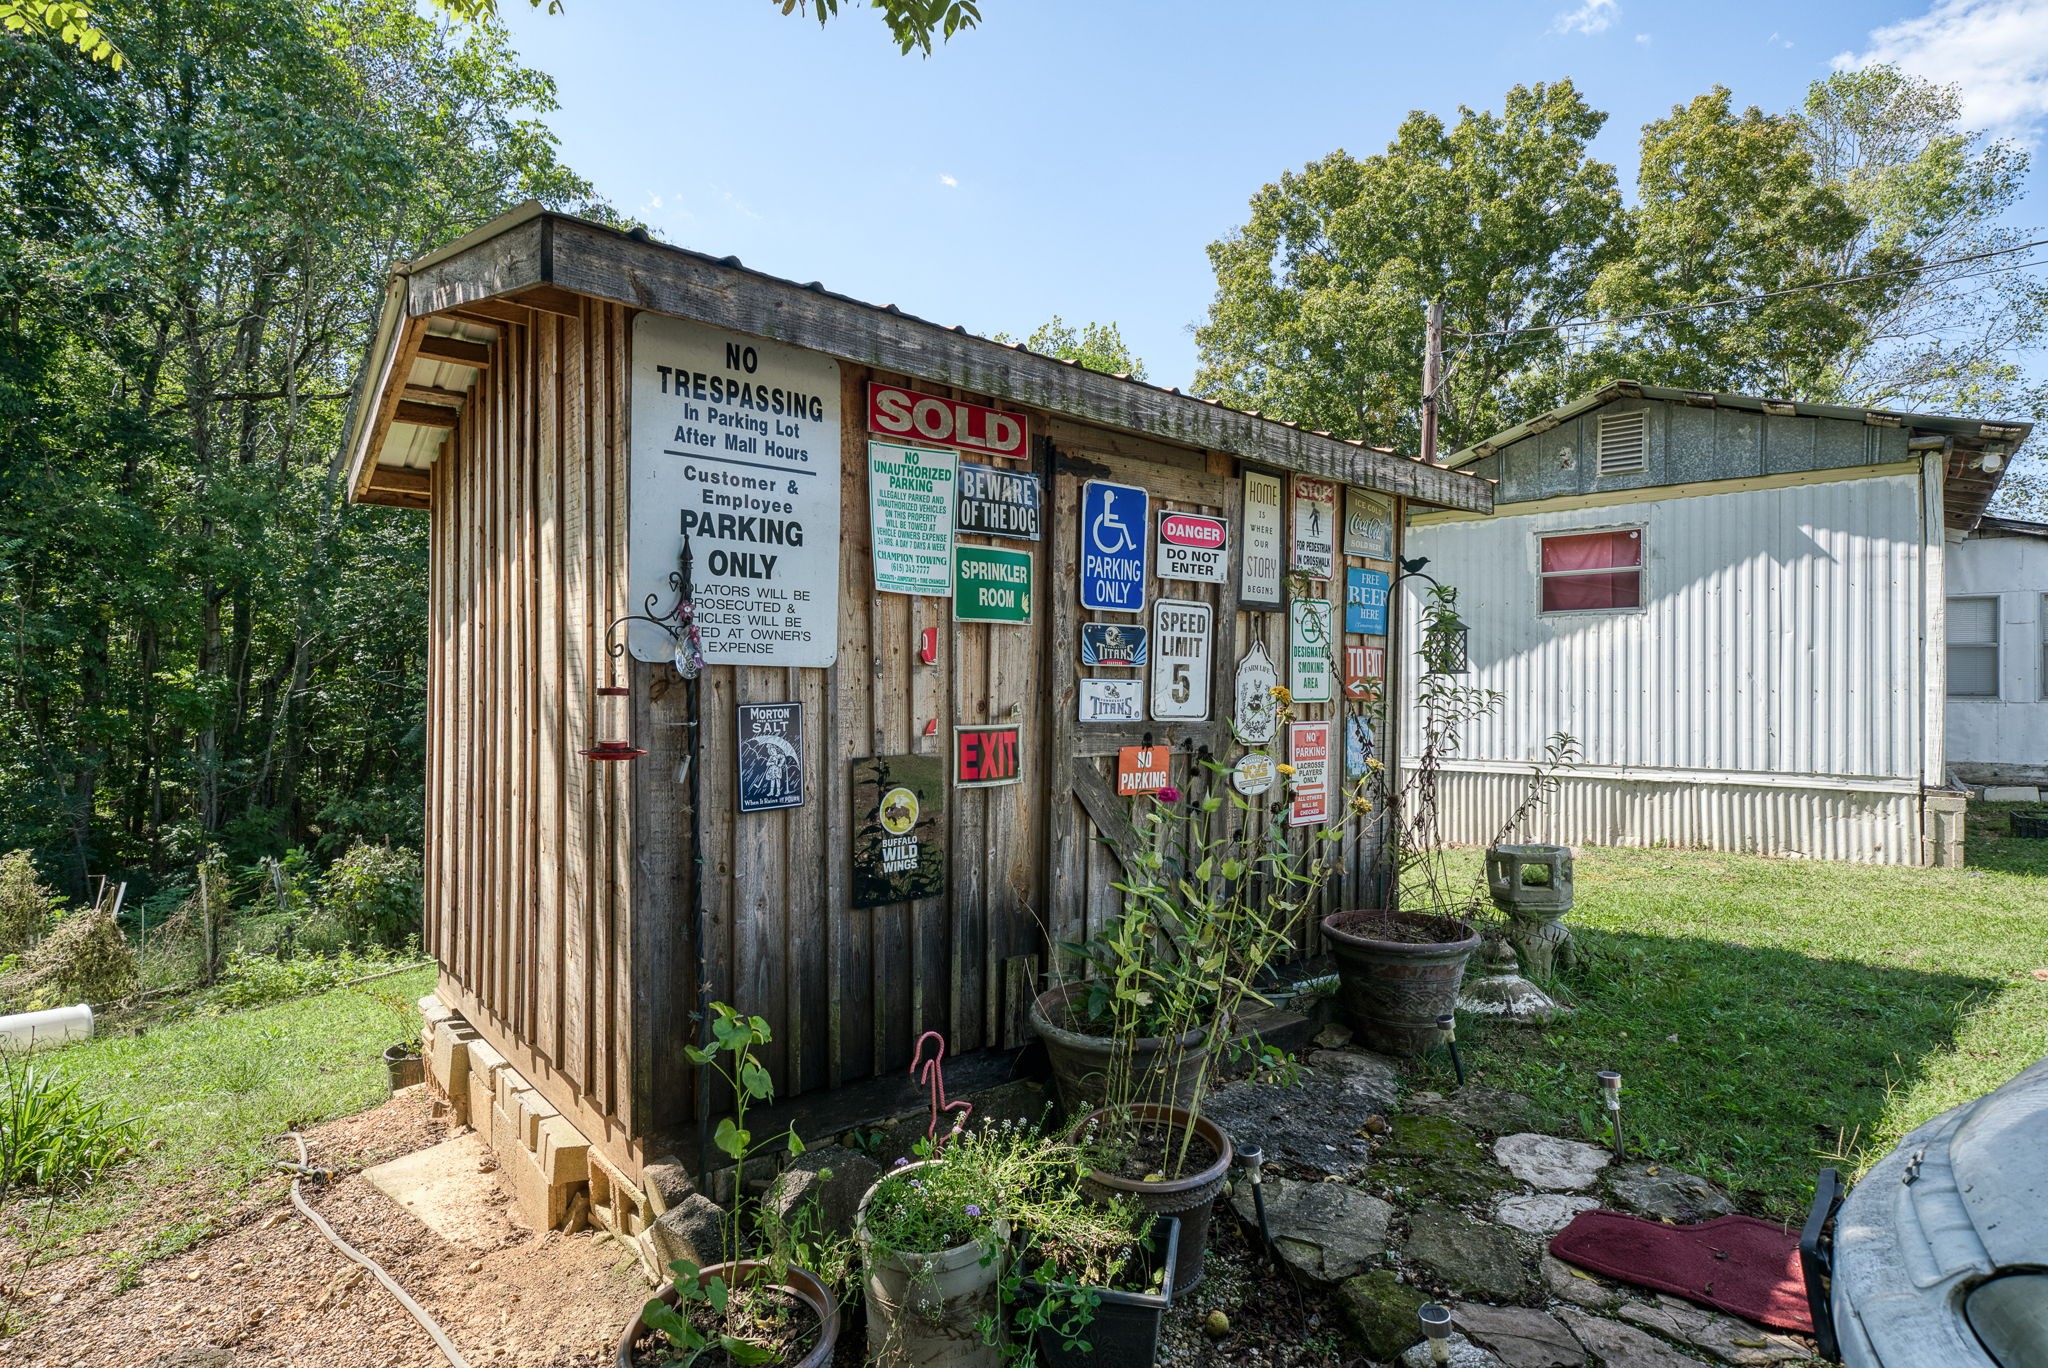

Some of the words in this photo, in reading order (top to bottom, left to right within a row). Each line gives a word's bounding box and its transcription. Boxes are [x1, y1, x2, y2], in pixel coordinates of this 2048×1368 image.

[726, 342, 758, 374] NO
[656, 365, 823, 423] TRESPASSING
[684, 403, 699, 421] In
[707, 407, 768, 436] Parking
[776, 419, 800, 439] Lot
[875, 389, 1022, 451] SOLD
[674, 426, 716, 447] After
[725, 433, 757, 454] Mall
[765, 439, 809, 462] Hours
[904, 451, 919, 465] NO
[874, 460, 952, 482] UNAUTHORIZED
[683, 465, 776, 492] Customer
[787, 480, 799, 495] &
[889, 475, 933, 493] PARKING
[963, 471, 1033, 505] BEWARE
[702, 489, 793, 514] Employee
[879, 489, 907, 501] ILLEGALLY
[908, 493, 931, 504] PARKED
[932, 496, 944, 505] AND
[1249, 481, 1277, 507] HOME
[877, 498, 918, 512] UNAUTHORIZED
[919, 504, 947, 514] VEHICLES
[1355, 498, 1366, 509] ICE
[885, 509, 893, 518] ON
[894, 510, 907, 520] THIS
[908, 512, 938, 523] PROPERTY
[961, 499, 979, 526] OF
[982, 502, 1008, 530] THE
[1009, 506, 1036, 533] DOG
[1259, 510, 1266, 519] IS
[680, 509, 803, 547] PARKING
[886, 519, 898, 528] WILL
[900, 521, 907, 529] BE
[908, 522, 928, 531] TOWED
[928, 523, 937, 532] AT
[1167, 522, 1220, 541] DANGER
[1250, 524, 1273, 535] WHERE
[877, 527, 897, 537] VEHICLE
[898, 530, 920, 540] OWNERS
[922, 532, 947, 542] EXPENSE
[900, 539, 909, 548] DAY
[913, 541, 926, 550] DAYS
[932, 543, 946, 552] WEEK
[1254, 539, 1269, 549] OUR
[1296, 540, 1305, 551] FOR
[1306, 541, 1331, 554] PEDESTRIAN
[877, 550, 914, 563] CHAMPION
[915, 555, 947, 566] TOWING
[1167, 548, 1187, 560] DO
[1191, 551, 1220, 564] NOT
[1297, 554, 1302, 564] IN
[1303, 555, 1330, 567] CROSSWALK
[708, 550, 778, 580] ONLY
[961, 560, 1027, 584] SPRINKLER
[1087, 555, 1141, 582] PARKING
[1171, 562, 1214, 576] ENTER
[1247, 555, 1277, 579] STORY
[1361, 573, 1380, 586] FREE
[757, 587, 788, 600] WILL
[794, 590, 811, 602] BE
[979, 587, 1015, 608] ROOM
[1096, 580, 1132, 604] ONLY
[1248, 585, 1274, 596] BEGINS
[787, 604, 796, 614] &
[1360, 608, 1379, 620] HERE
[671, 610, 741, 625] VHICLES
[748, 615, 779, 627] WILL
[785, 617, 802, 628] BE
[1160, 611, 1206, 634] SPEED
[728, 628, 745, 639] AT
[751, 629, 812, 642] OWNER'S
[708, 641, 774, 654] EXPENSE
[1096, 642, 1134, 661] TITANS
[1161, 635, 1203, 658] LIMIT
[1244, 665, 1259, 674] FARM
[1259, 665, 1271, 675] LIFE
[1298, 662, 1324, 674] SMOKING
[1348, 648, 1364, 677] TO
[1366, 648, 1382, 677] EXIT
[1171, 663, 1190, 704] 5
[1303, 677, 1319, 689] AREA
[1090, 695, 1132, 716] TITANS
[752, 721, 789, 733] SALT
[1306, 732, 1316, 742] NO
[960, 731, 1016, 780] EXIT
[1137, 751, 1152, 768] NO
[1296, 746, 1325, 757] PARKING
[1297, 761, 1324, 770] LACROSSE
[1299, 769, 1323, 777] PLAYERS
[1120, 771, 1167, 790] PARKING
[1303, 775, 1318, 784] ONLY
[882, 835, 918, 847] BUFFALO
[882, 845, 918, 862] WILD
[883, 858, 918, 873] WINGS
